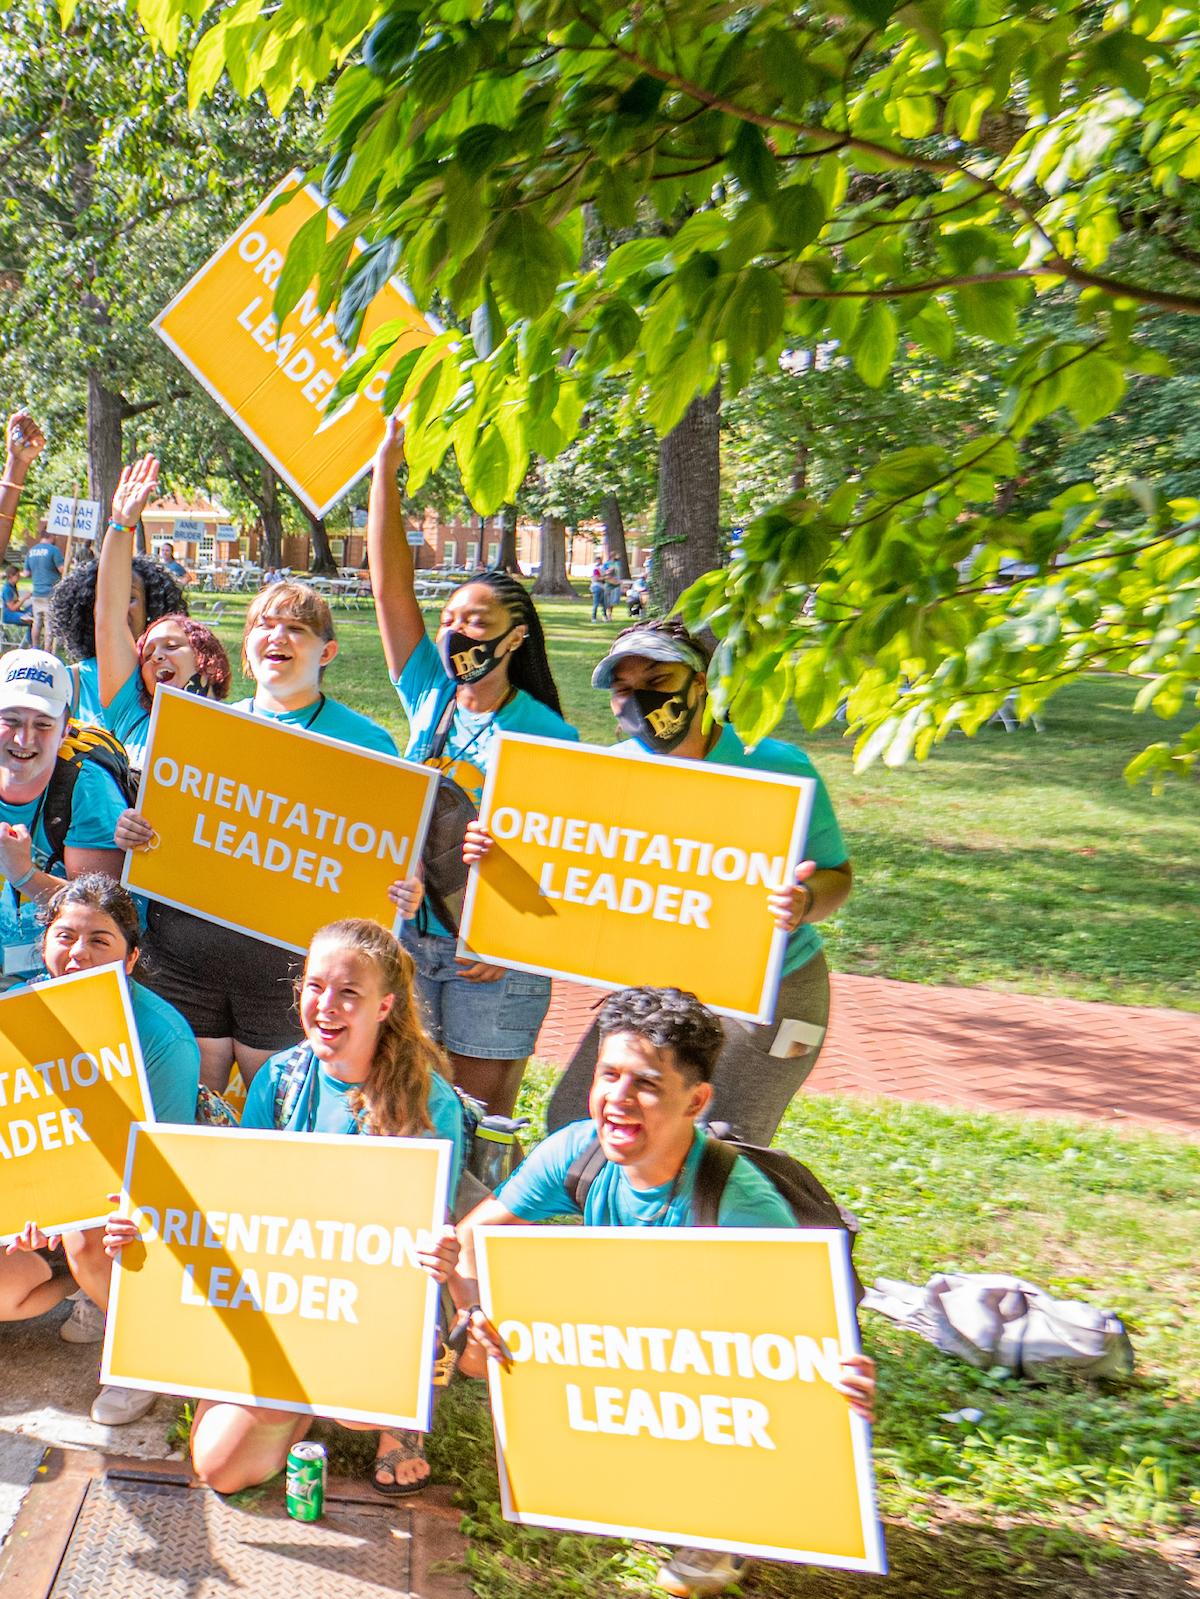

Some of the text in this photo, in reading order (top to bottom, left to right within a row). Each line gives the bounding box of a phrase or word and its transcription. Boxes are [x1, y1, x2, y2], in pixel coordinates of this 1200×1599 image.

[6, 667, 53, 689] BEREA
[450, 643, 489, 677] BC
[644, 695, 688, 737] BC
[153, 757, 409, 865] ORIENTATION
[193, 813, 343, 893] LEADER
[491, 807, 784, 890] ORIENTATION
[538, 862, 712, 929] LEADER
[130, 1205, 433, 1269] ORIENTATION
[180, 1264, 359, 1323] LEADER
[499, 1320, 843, 1386] ORIENTATION
[566, 1383, 776, 1450] LEADER
